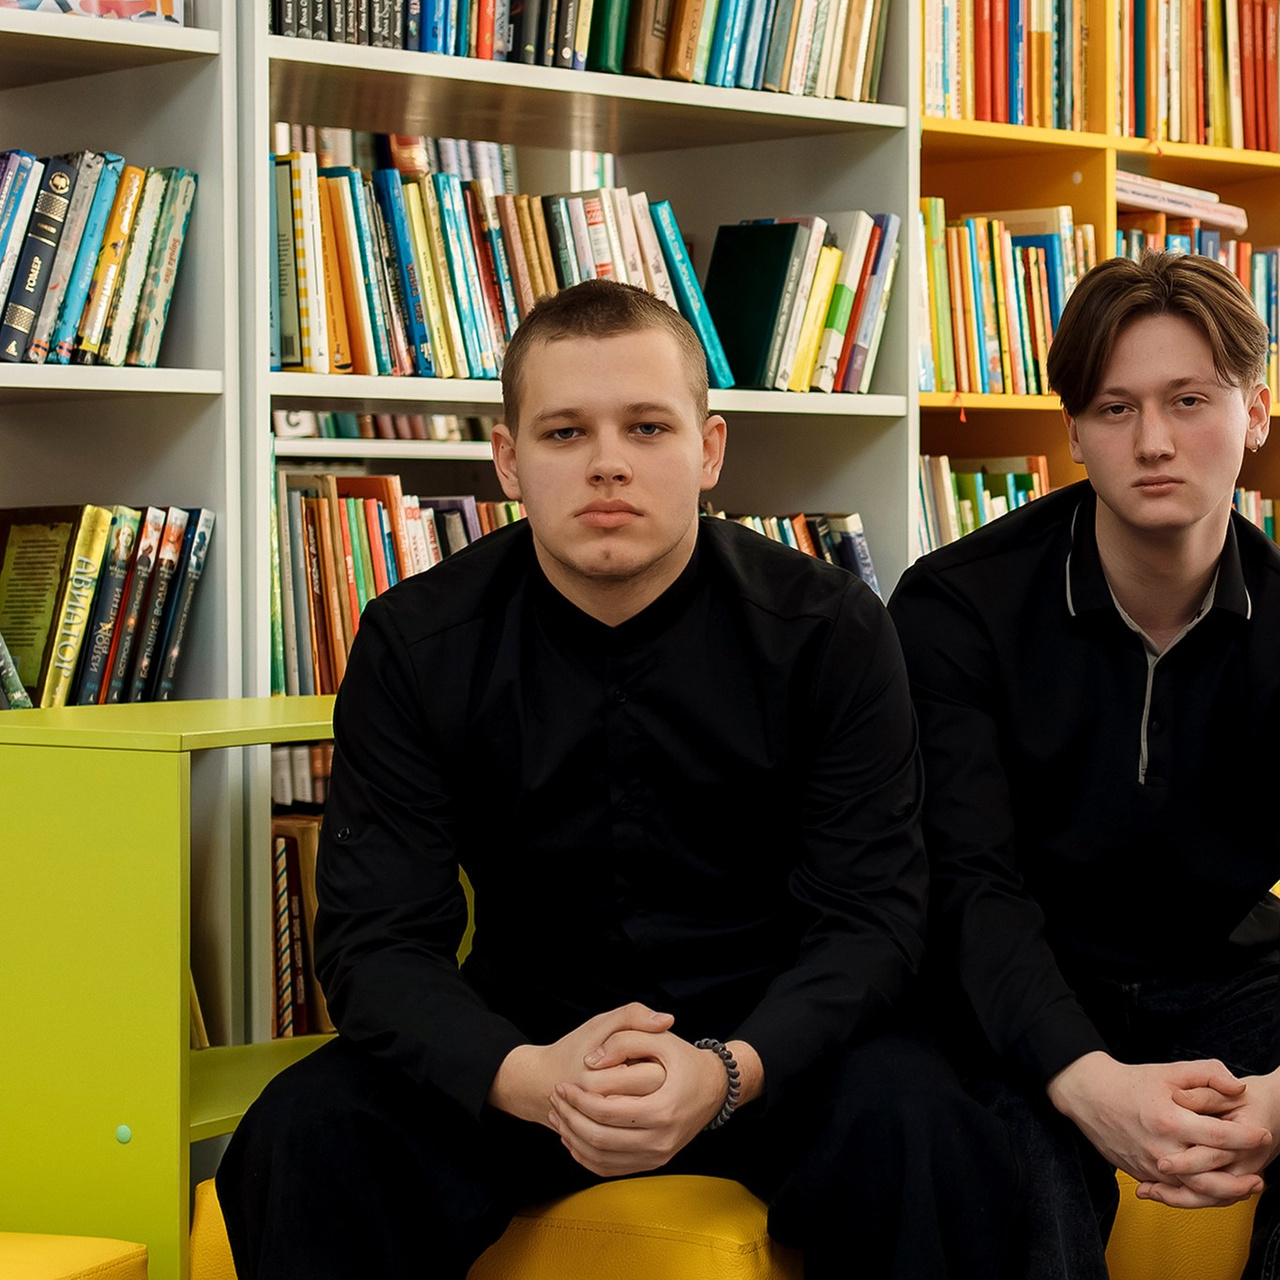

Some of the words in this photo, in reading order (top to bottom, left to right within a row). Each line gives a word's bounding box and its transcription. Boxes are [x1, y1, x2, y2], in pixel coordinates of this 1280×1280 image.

[24, 256, 43, 294] ГОМЕР
[54, 554, 99, 679] АВИАТОР
[89, 619, 112, 673] ИЗЛОМ
[101, 586, 122, 656] ВРЕМЕНИ
[139, 620, 161, 679] БОЛЬШИЕ
[154, 580, 169, 617] ВОДЫ
[116, 634, 134, 678] ОСТРОВА
